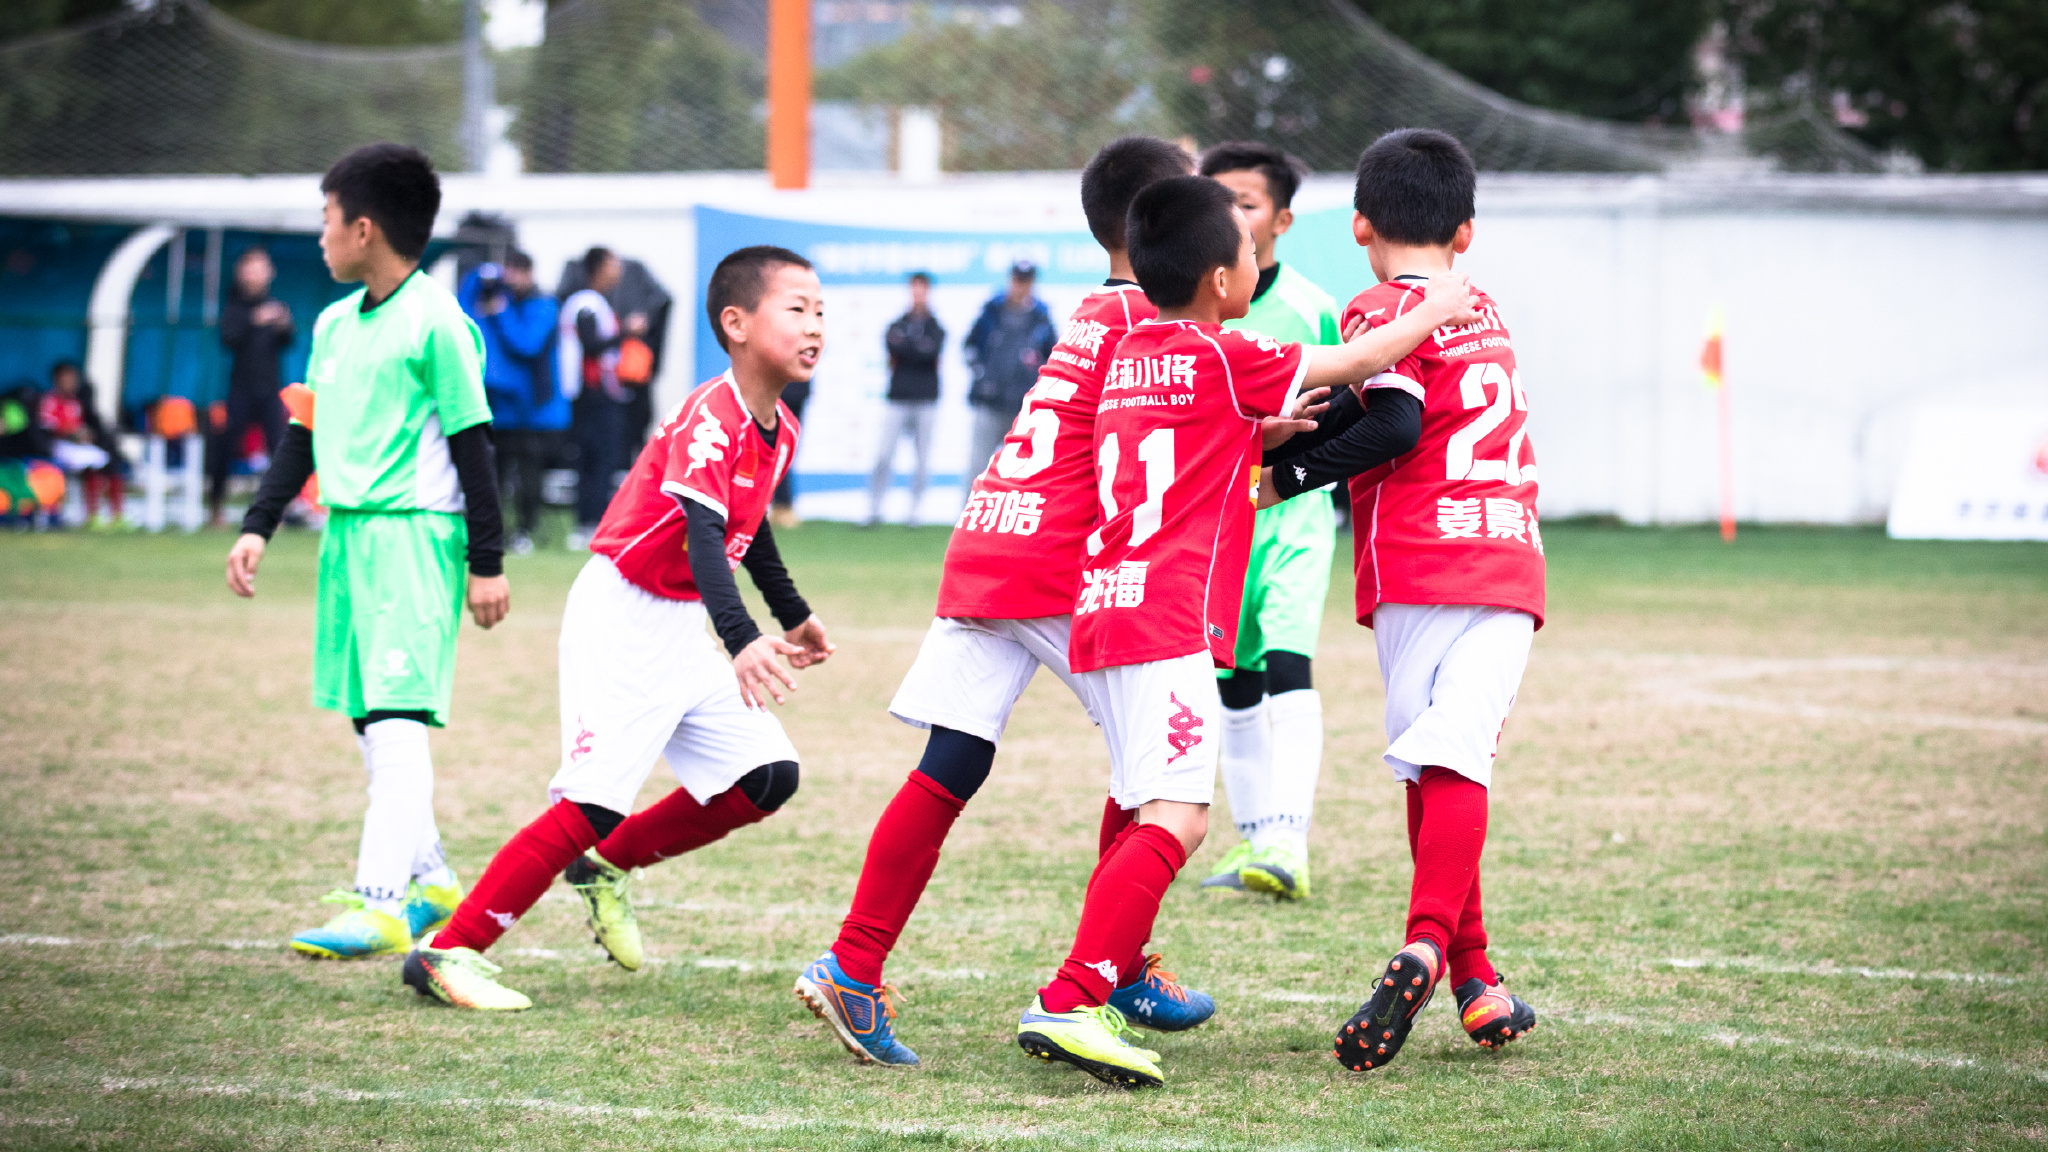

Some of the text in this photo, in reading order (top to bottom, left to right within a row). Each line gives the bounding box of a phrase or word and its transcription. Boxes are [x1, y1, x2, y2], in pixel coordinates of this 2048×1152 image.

[1077, 357, 1097, 371] BOY
[977, 375, 1079, 480] 5
[1120, 394, 1168, 409] FOOTBALL
[1170, 393, 1195, 406] BOY
[1086, 428, 1176, 557] 11
[1436, 496, 1544, 556] 姜景
